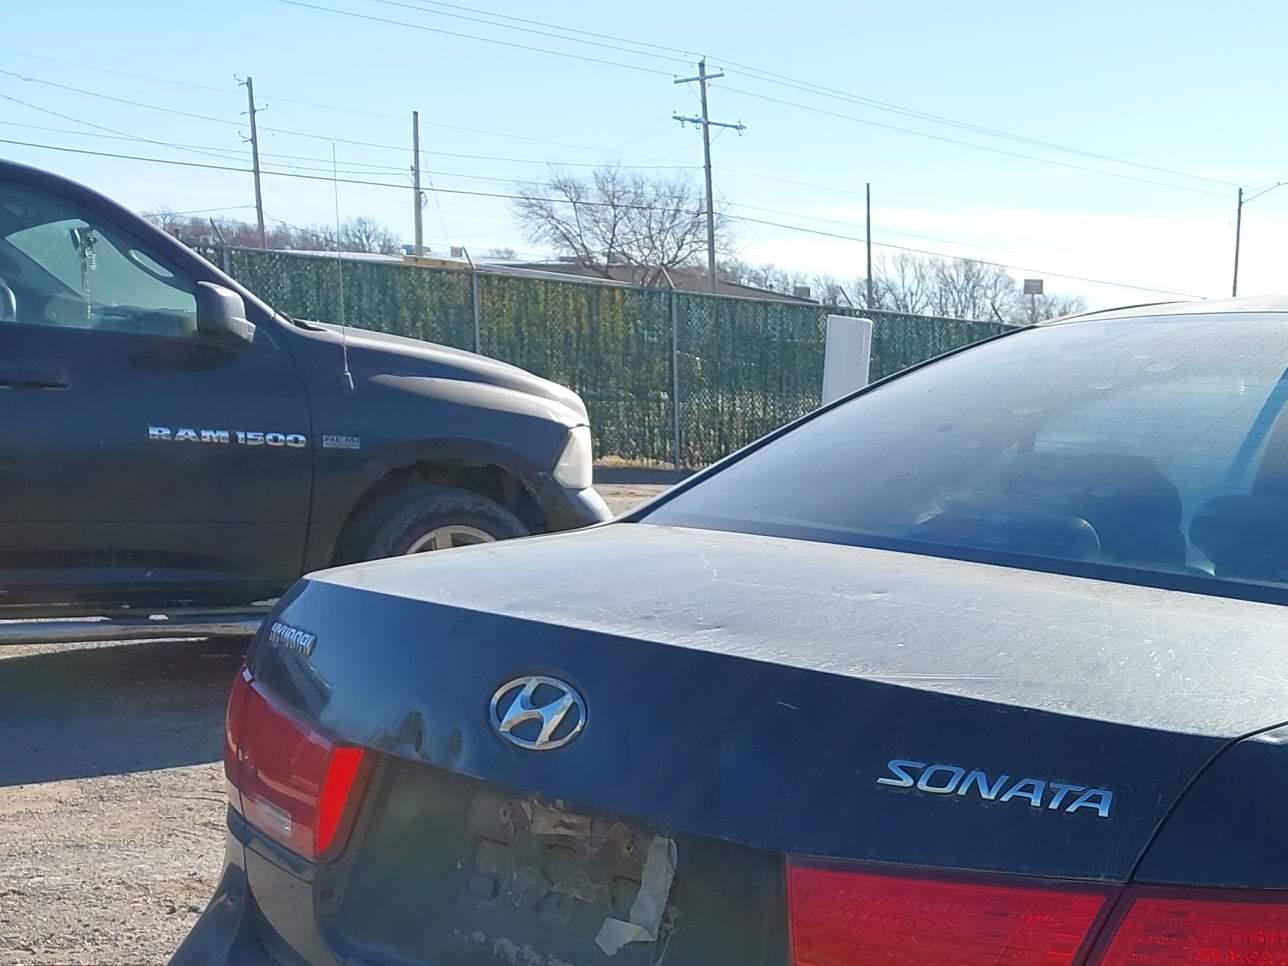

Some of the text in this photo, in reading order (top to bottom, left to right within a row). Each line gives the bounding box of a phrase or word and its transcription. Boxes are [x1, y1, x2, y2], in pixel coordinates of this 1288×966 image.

[149, 426, 230, 443] RAM
[235, 430, 307, 448] 1500
[876, 758, 1114, 818] SONATA
